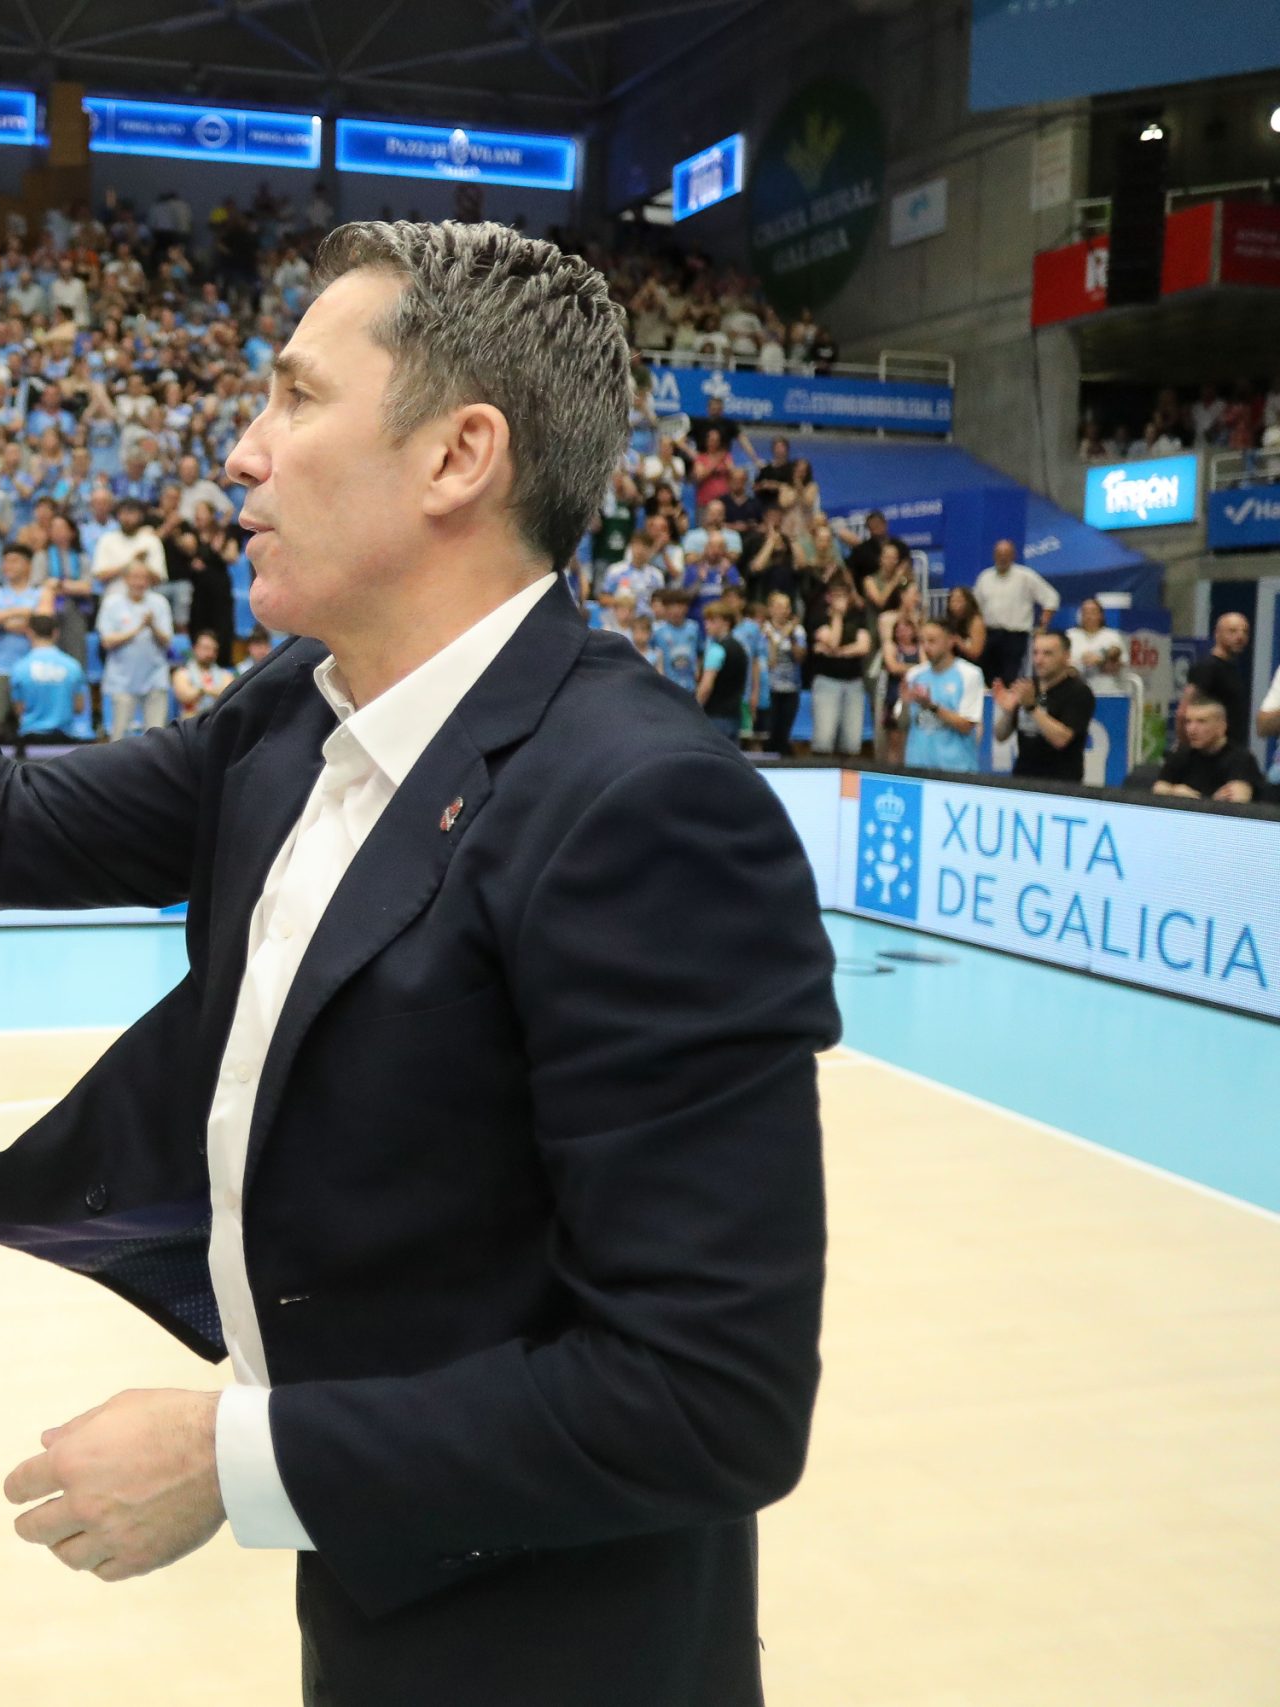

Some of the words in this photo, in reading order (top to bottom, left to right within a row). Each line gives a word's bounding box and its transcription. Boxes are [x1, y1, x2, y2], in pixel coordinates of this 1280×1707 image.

[940, 800, 1125, 880] XUNTA
[937, 866, 996, 927] DE
[1016, 882, 1269, 989] GALICIA
